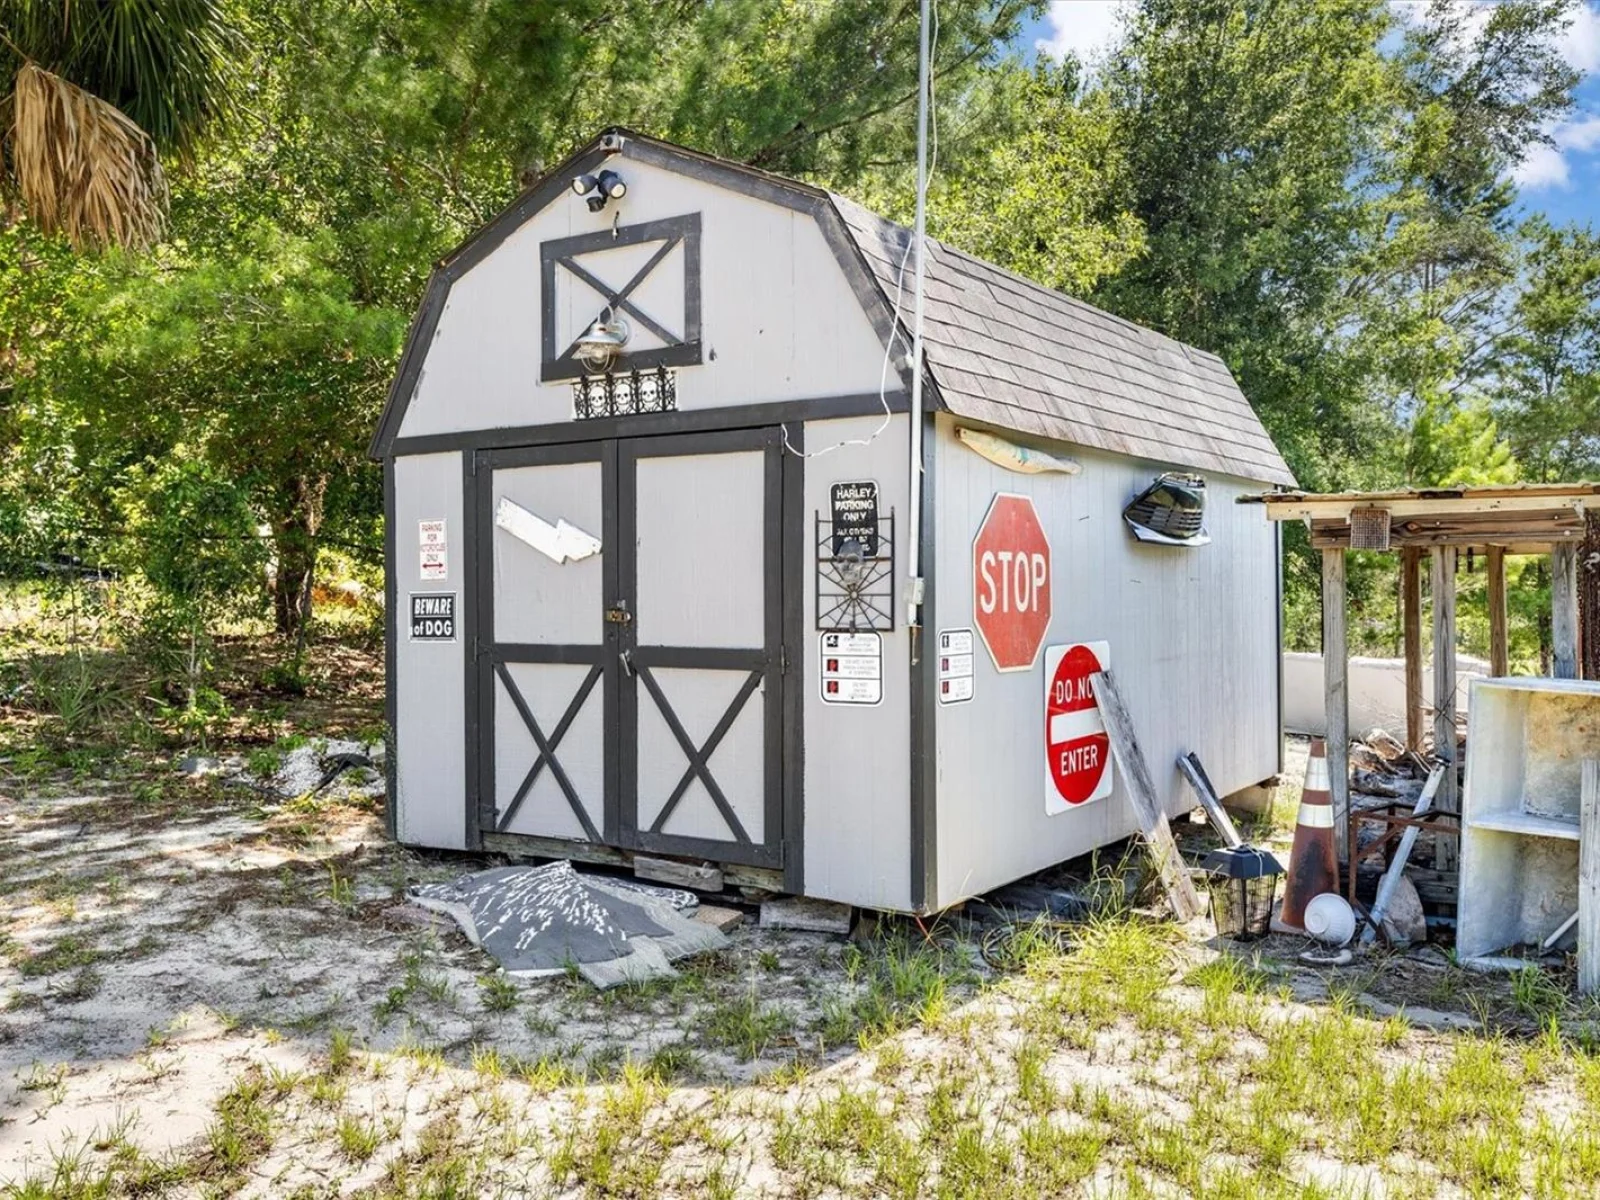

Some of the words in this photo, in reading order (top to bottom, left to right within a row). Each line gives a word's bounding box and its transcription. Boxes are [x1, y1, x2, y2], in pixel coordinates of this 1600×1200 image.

[836, 487, 871, 499] HARLEY
[835, 500, 874, 511] PARKING
[843, 512, 867, 521] ONLY
[980, 550, 1047, 614] STOP
[414, 598, 452, 615] BEWARE
[413, 621, 424, 636] of
[425, 619, 453, 636] DOG
[1056, 679, 1073, 705] DO
[1078, 676, 1095, 700] NO
[1061, 744, 1098, 777] ENTER
